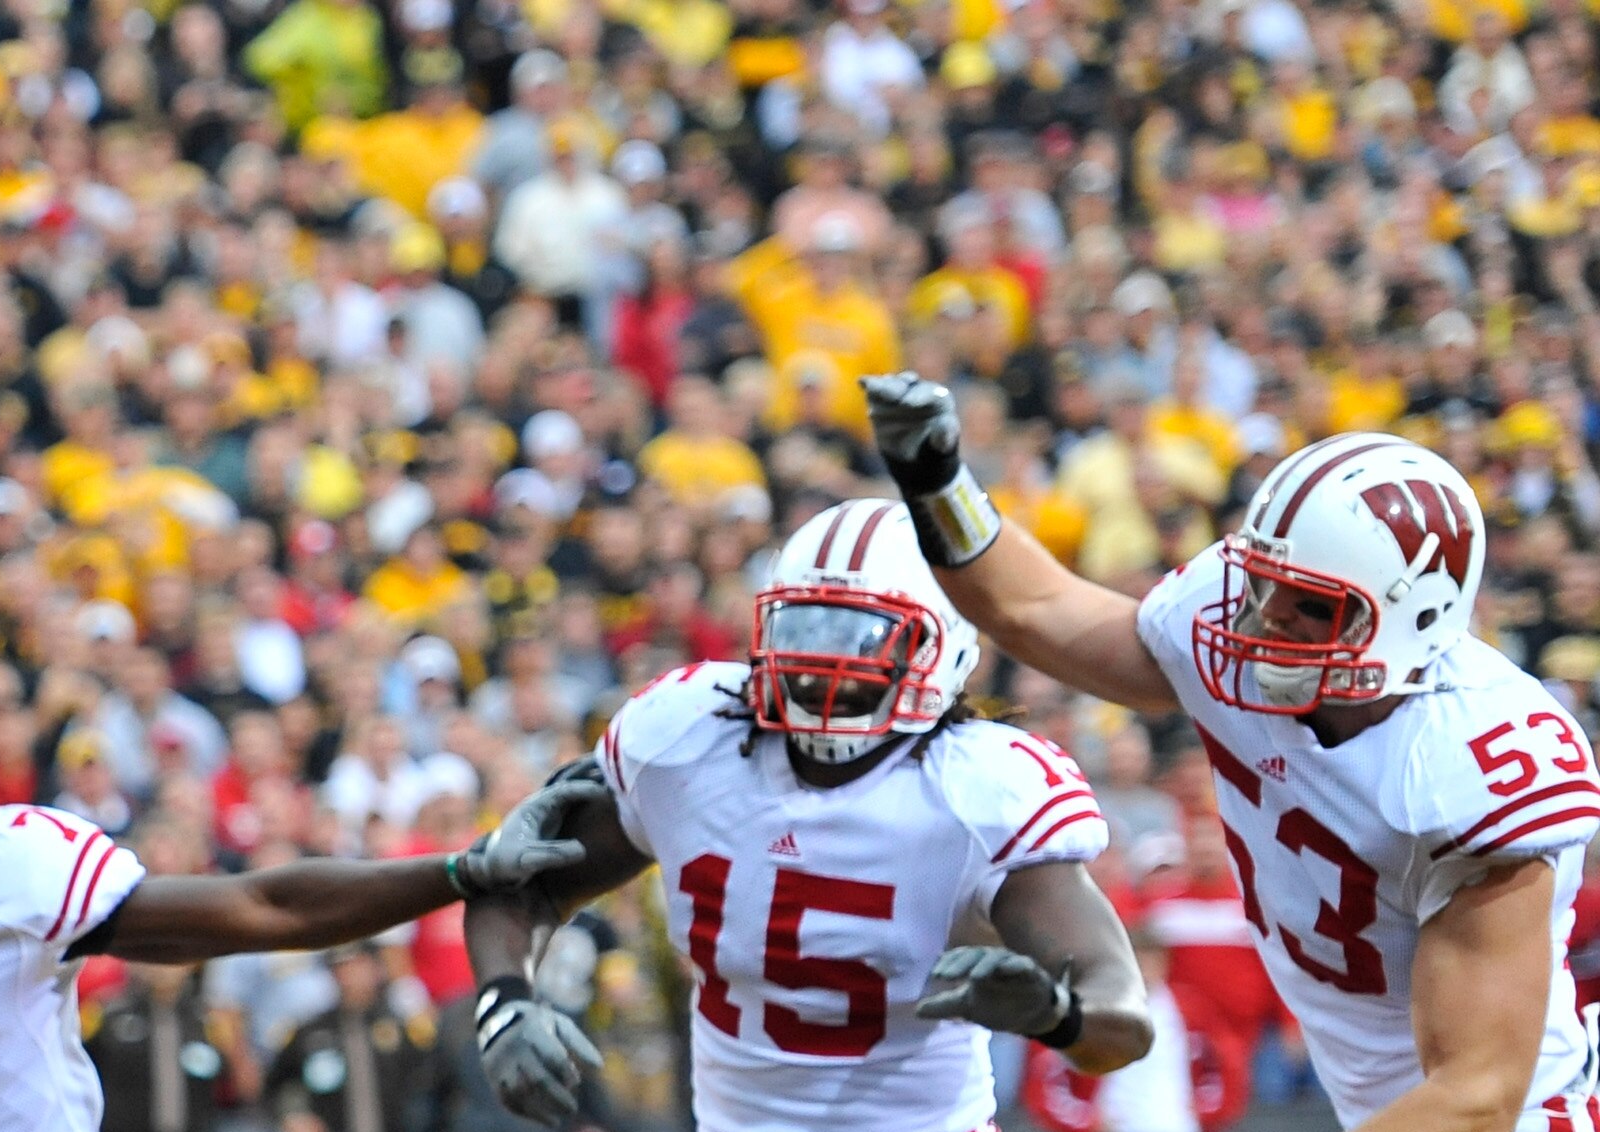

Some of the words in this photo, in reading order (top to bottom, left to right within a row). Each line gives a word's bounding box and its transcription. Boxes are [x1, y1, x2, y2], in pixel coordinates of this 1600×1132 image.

[1359, 480, 1474, 594] W
[1467, 712, 1588, 797] 53
[679, 853, 895, 1057] 15
